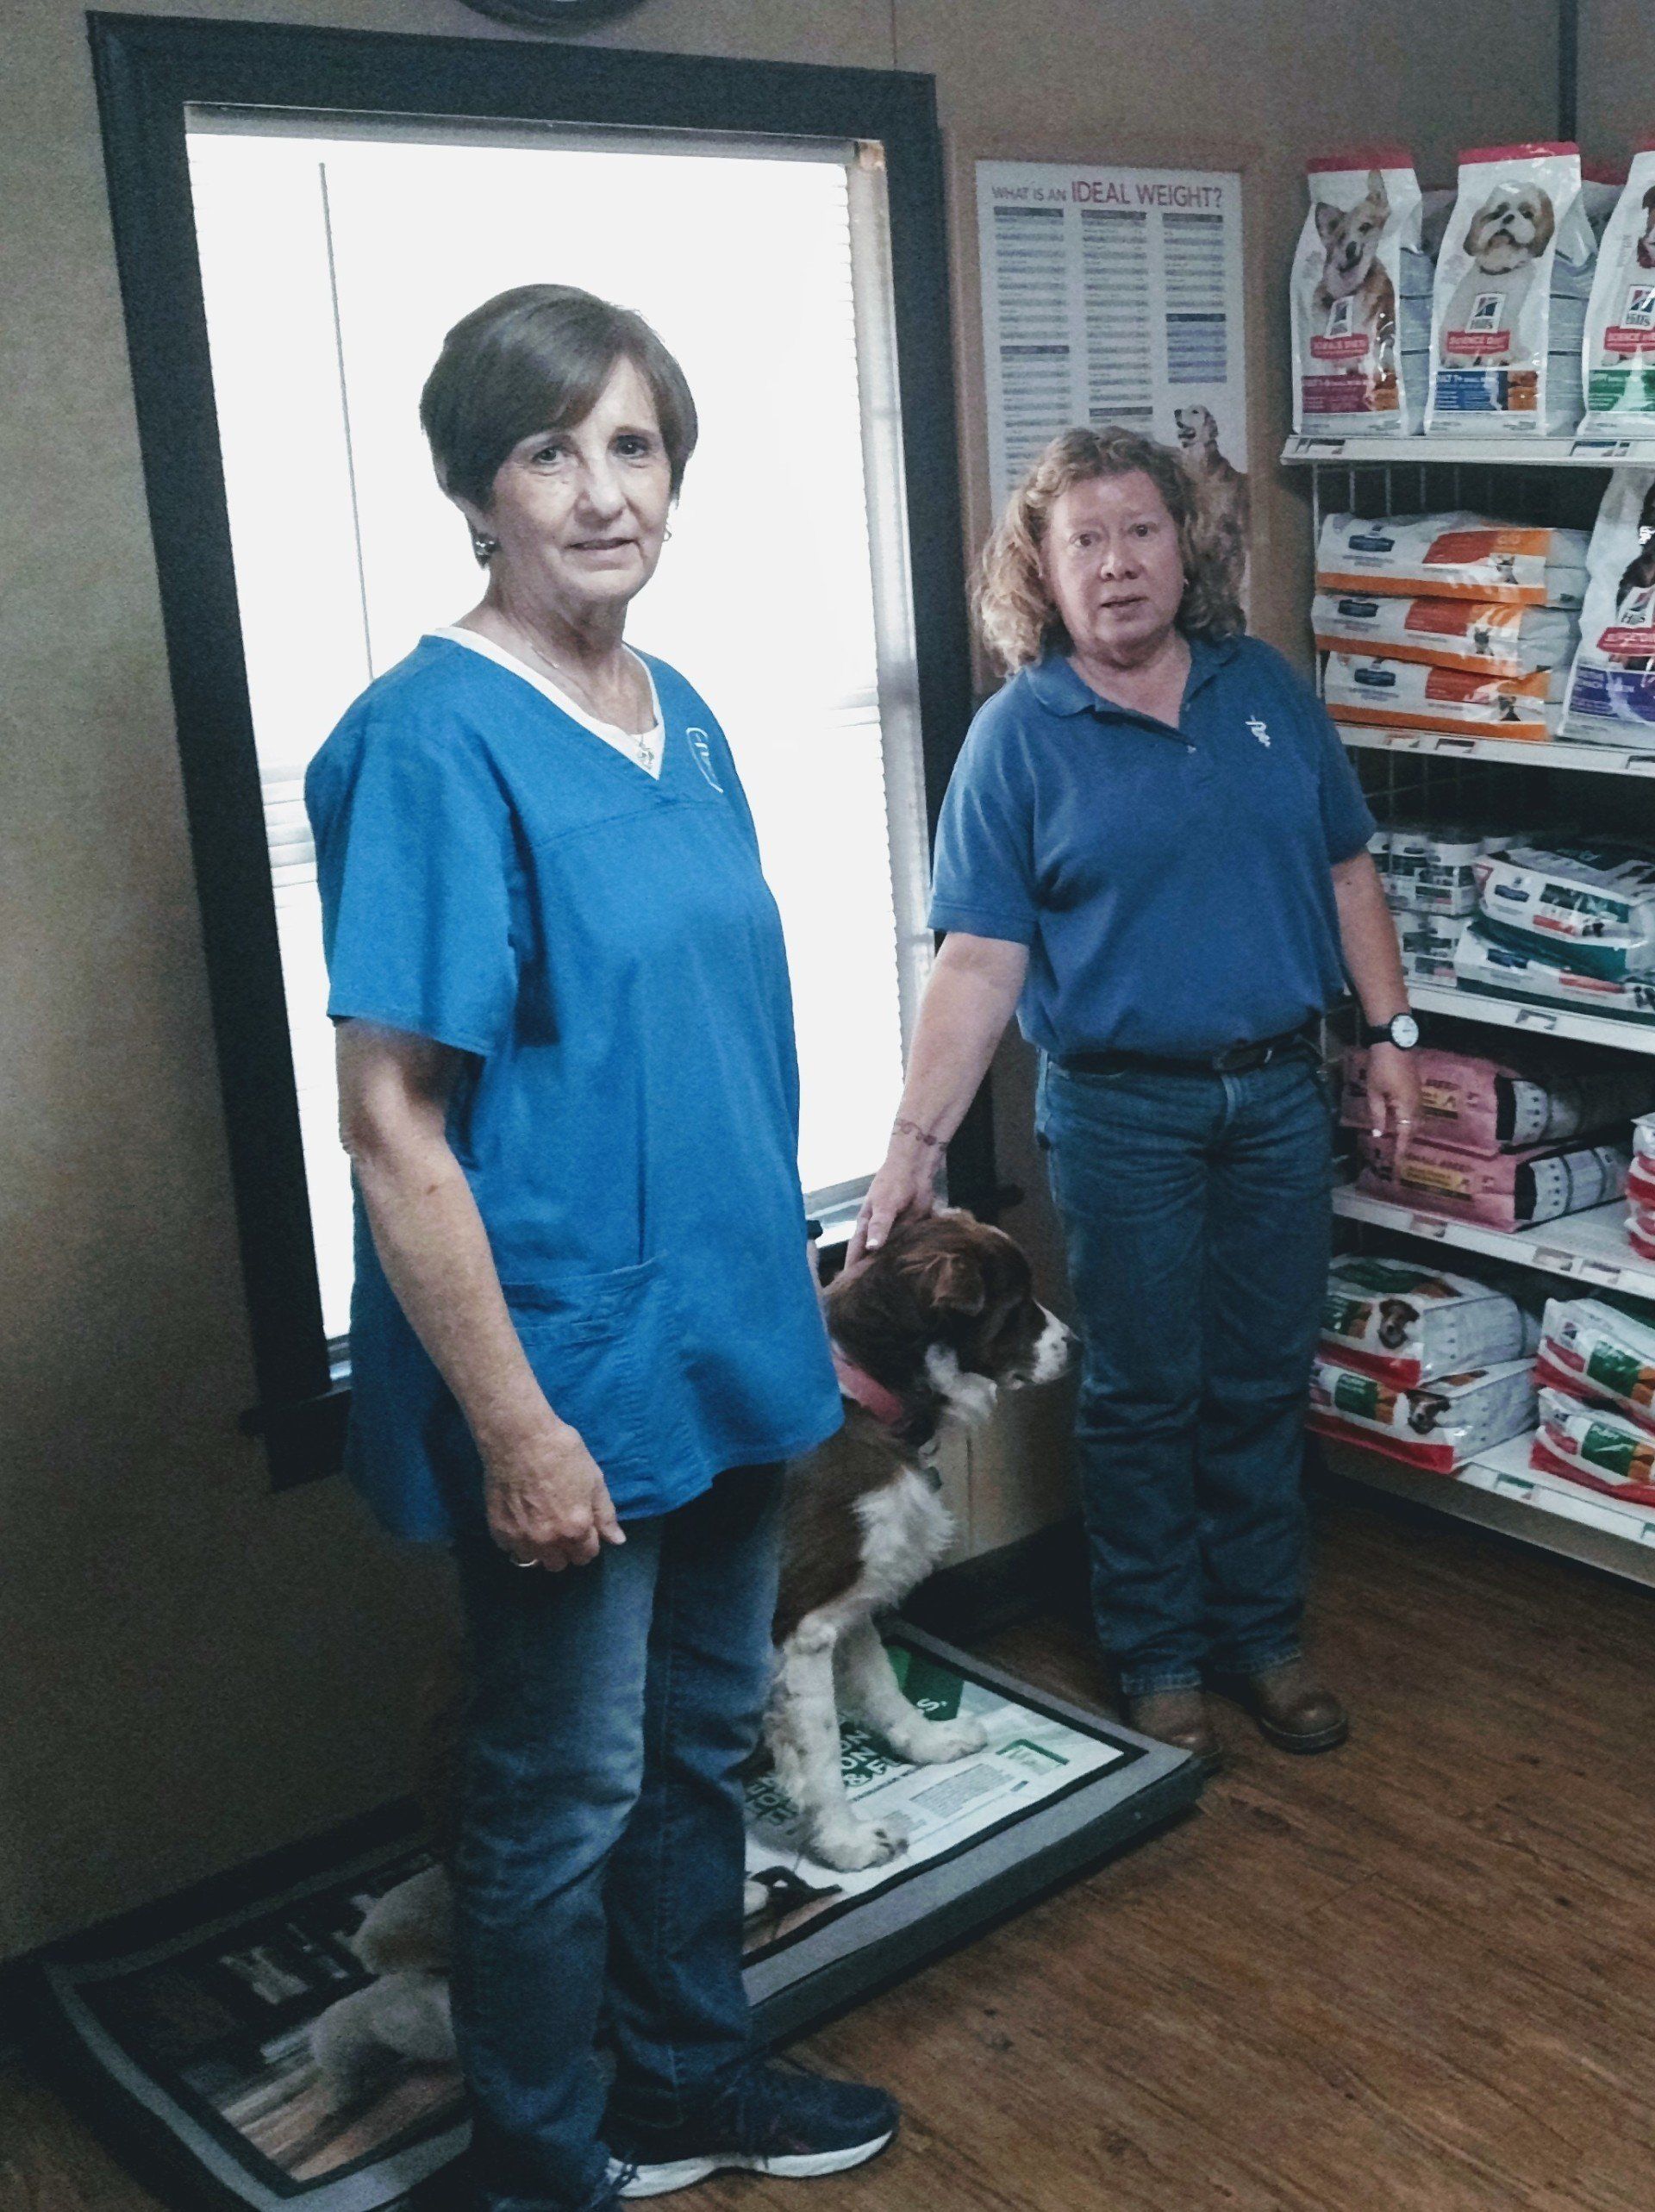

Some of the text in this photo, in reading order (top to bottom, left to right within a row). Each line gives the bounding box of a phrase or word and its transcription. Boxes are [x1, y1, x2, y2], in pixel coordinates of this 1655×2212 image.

[991, 180, 1222, 208] WHAT IS AN IDEAL WEIGHT?
